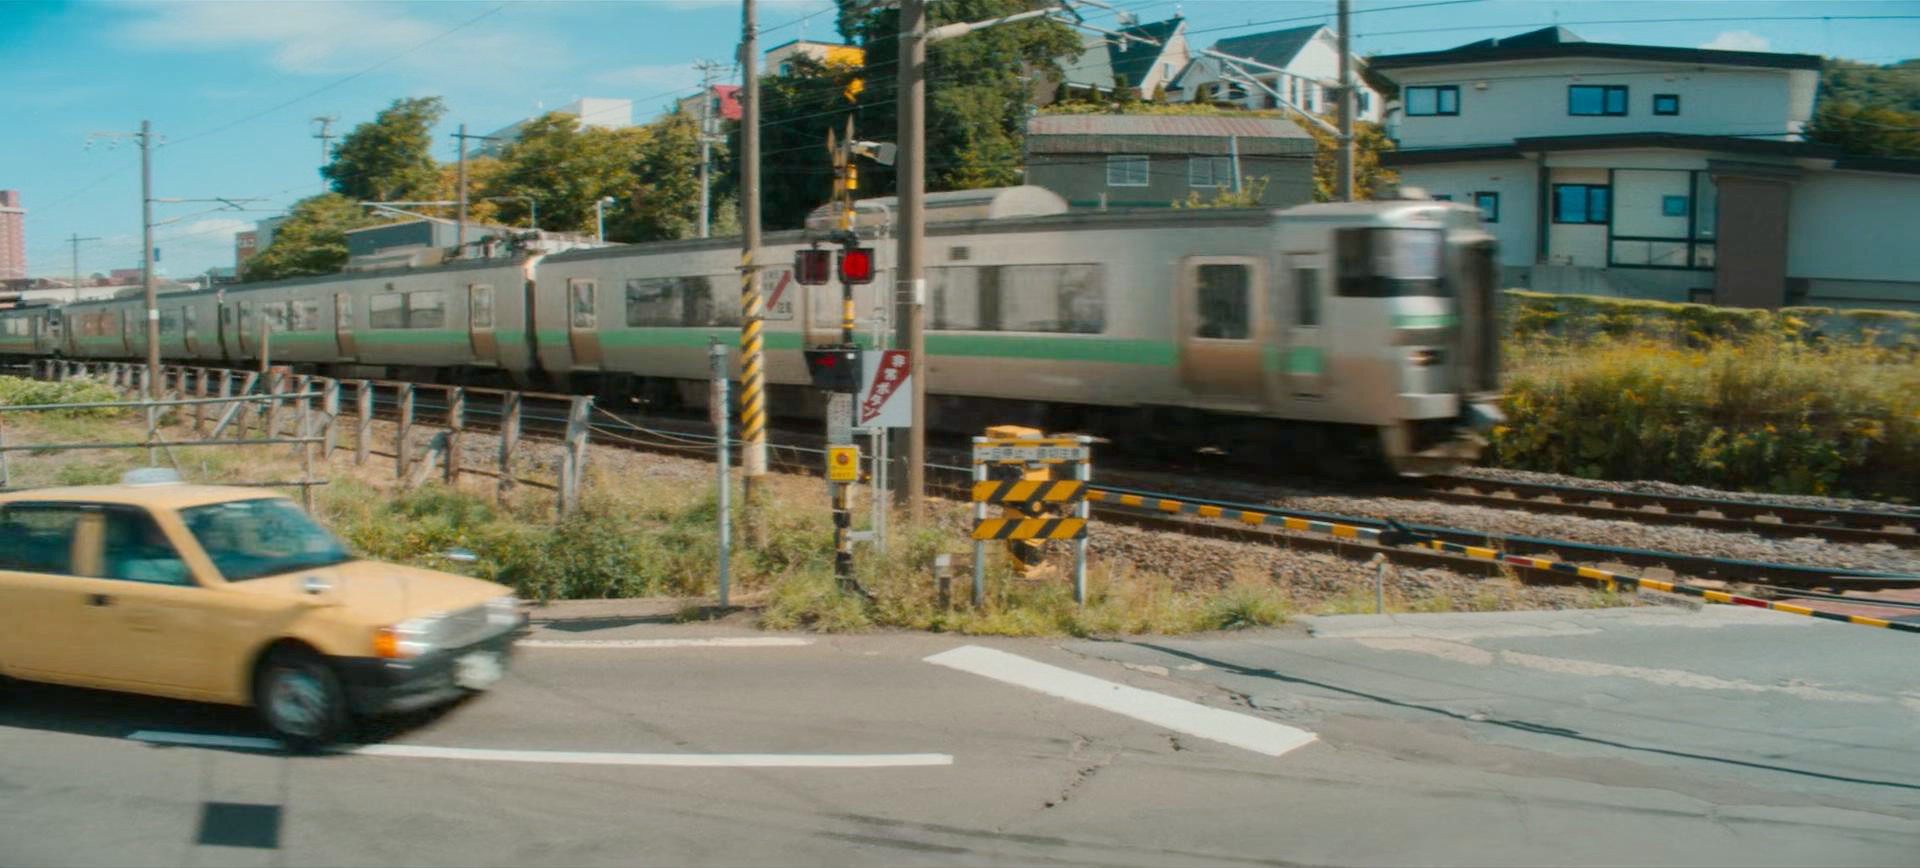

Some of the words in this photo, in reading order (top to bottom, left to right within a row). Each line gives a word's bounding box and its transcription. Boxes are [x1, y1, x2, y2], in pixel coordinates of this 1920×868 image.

[863, 354, 906, 417] 非常ボタン
